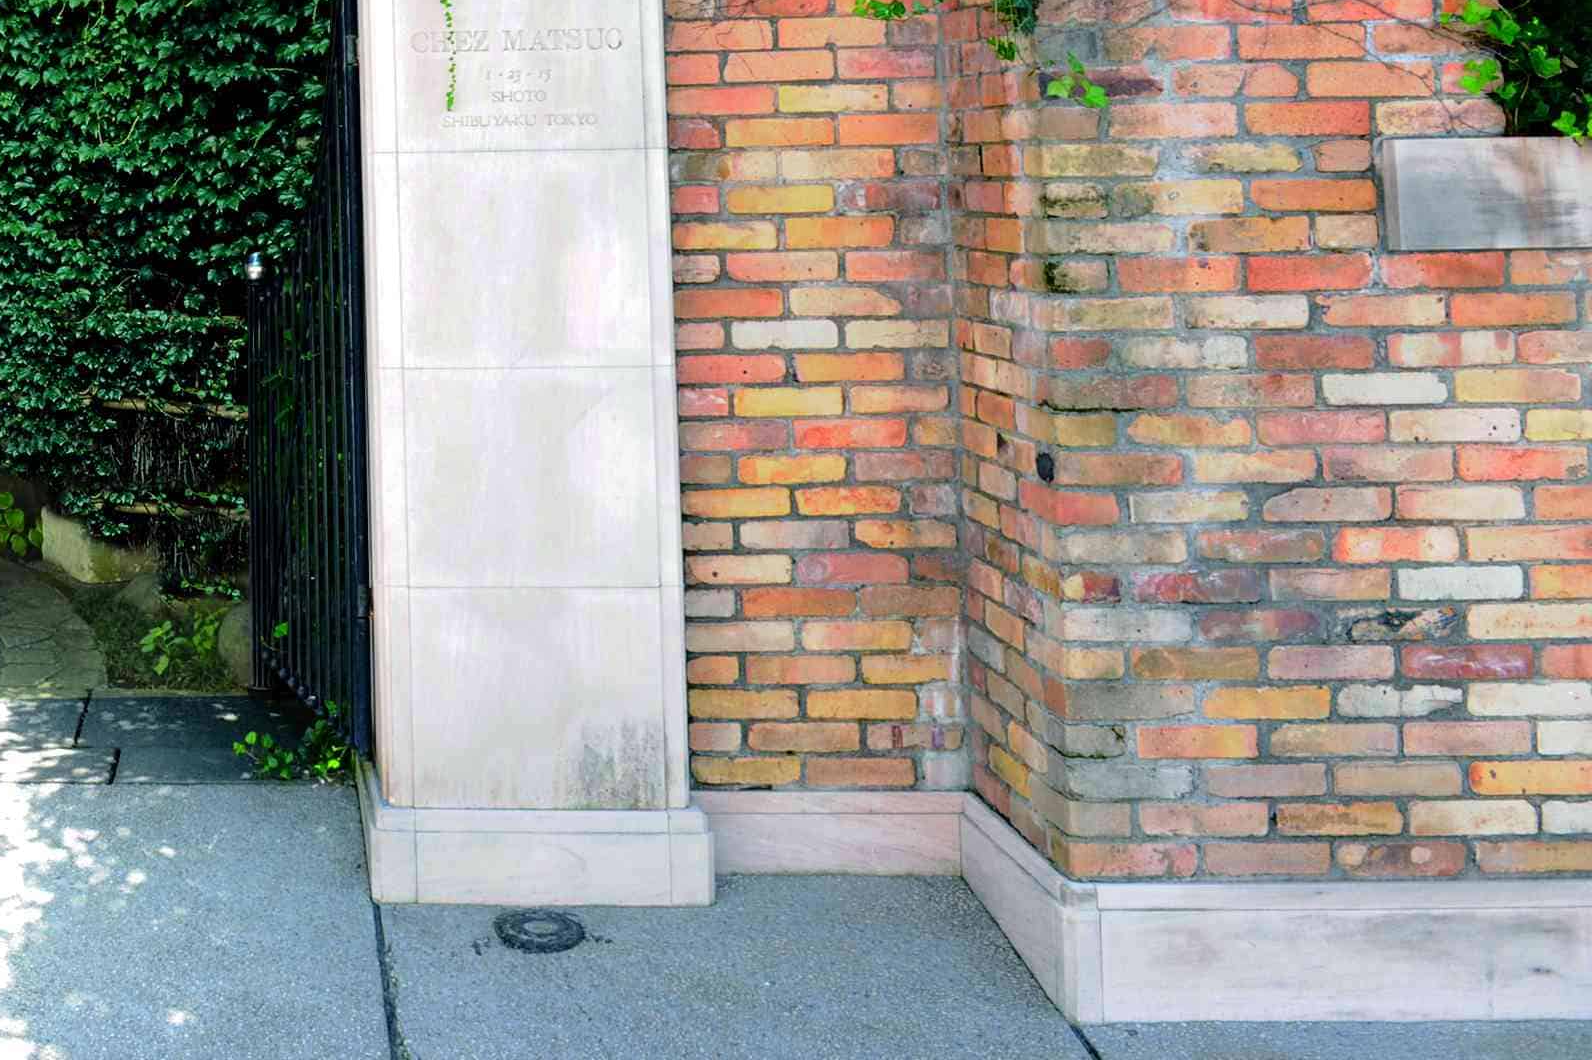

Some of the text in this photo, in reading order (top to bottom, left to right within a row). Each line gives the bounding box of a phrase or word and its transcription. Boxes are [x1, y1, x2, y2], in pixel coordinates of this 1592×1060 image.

[409, 27, 624, 53] CHEZ MATSUO
[491, 90, 547, 103] SHOTO
[544, 113, 599, 127] TOKYO
